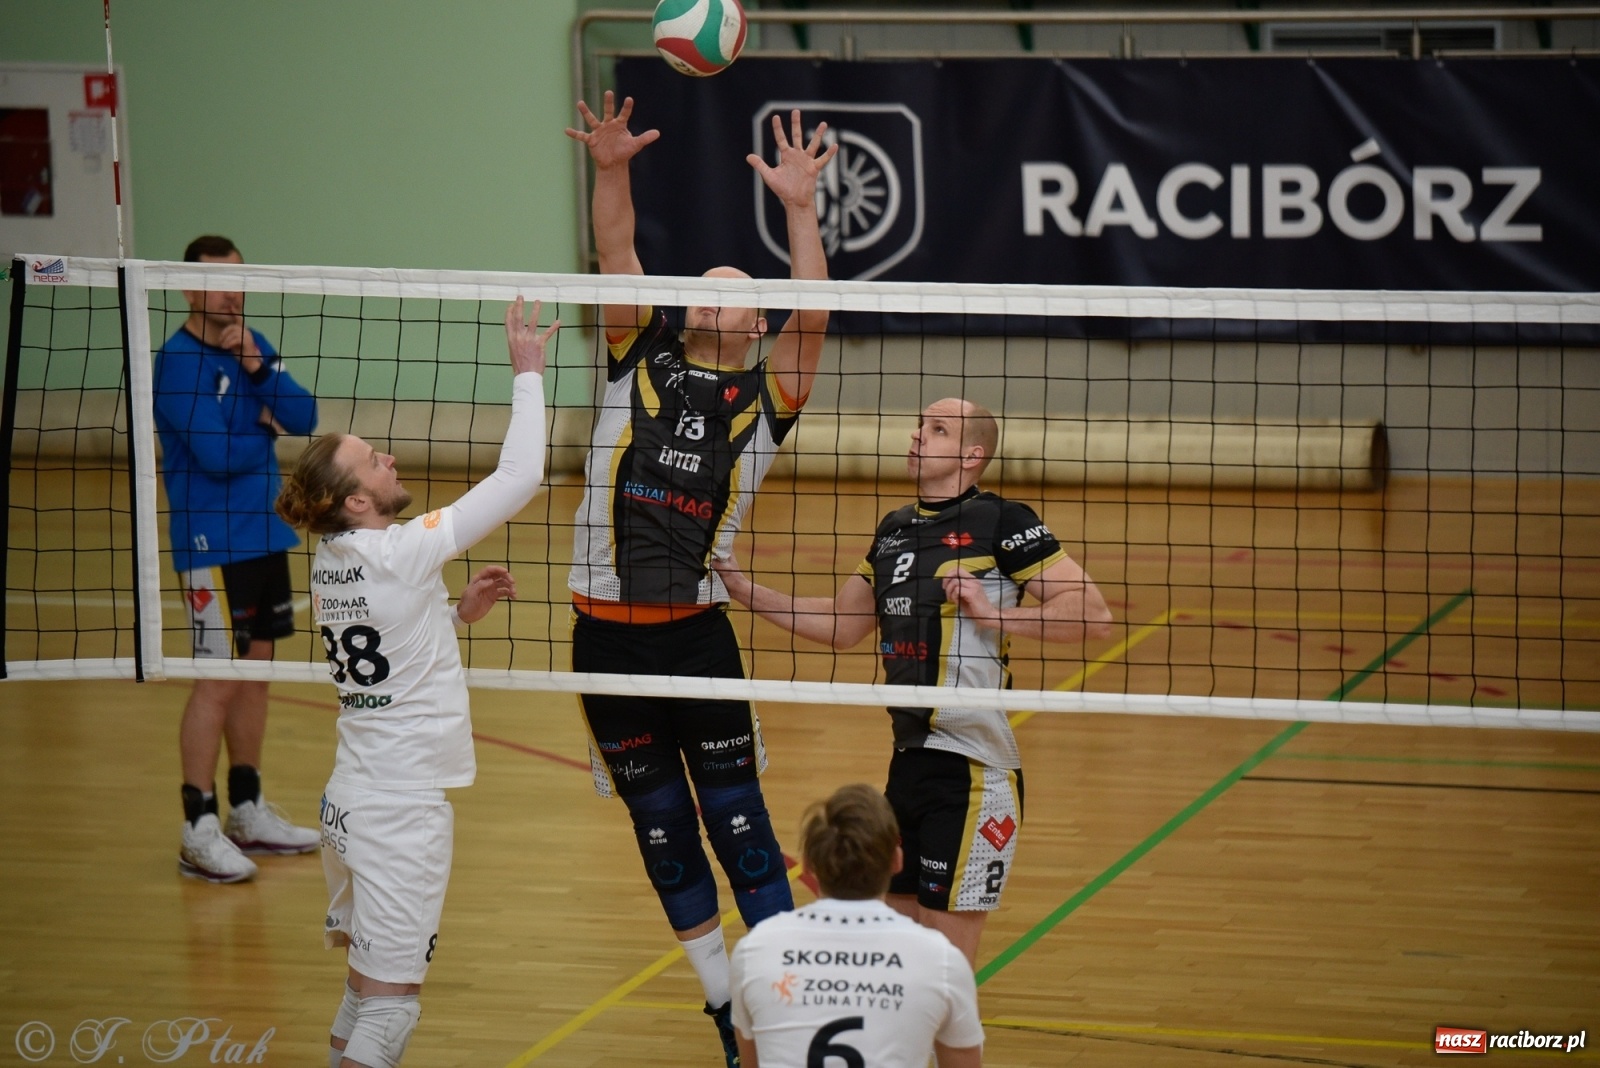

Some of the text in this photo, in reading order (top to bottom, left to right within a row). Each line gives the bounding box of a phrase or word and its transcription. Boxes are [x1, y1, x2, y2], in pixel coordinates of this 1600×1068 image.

[1021, 137, 1543, 242] RACIBÓRZ
[675, 410, 705, 441] 13
[658, 445, 702, 473] ENTER
[194, 534, 209, 553] 13
[312, 566, 365, 585] MICHALAK
[891, 552, 915, 584] 2
[322, 609, 370, 621] LUNATYCY
[701, 733, 751, 750] GRAVTON
[987, 821, 1006, 842] Enter
[986, 860, 1005, 893] 2
[782, 950, 903, 968] SKORUPA
[802, 994, 903, 1011] LUNATYCY
[806, 1015, 865, 1068] 6
